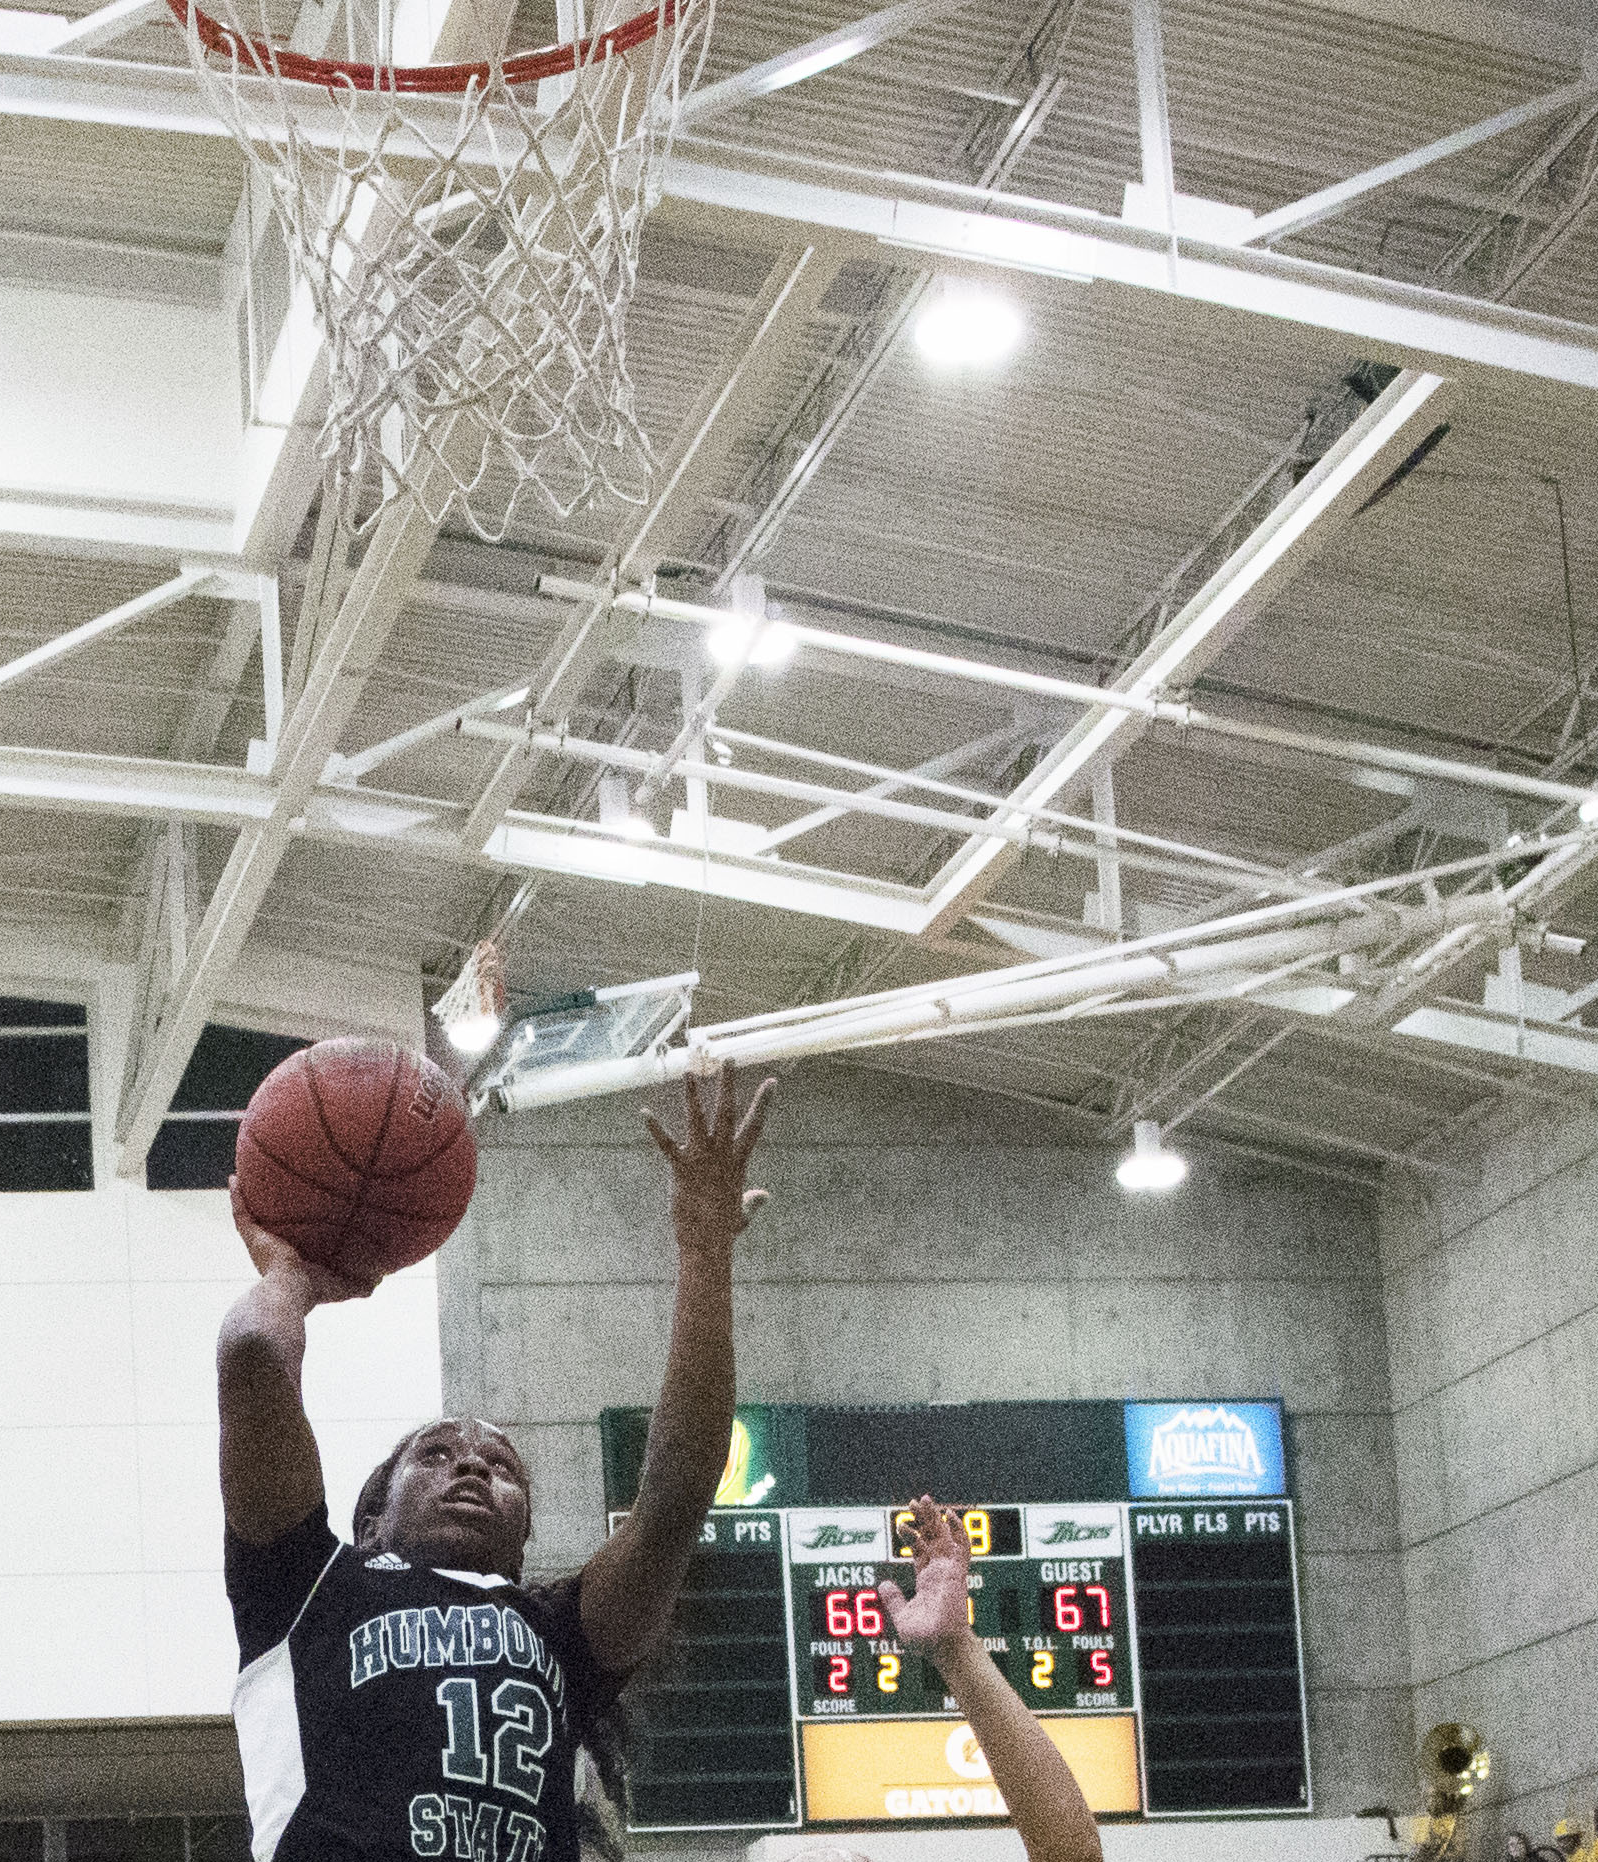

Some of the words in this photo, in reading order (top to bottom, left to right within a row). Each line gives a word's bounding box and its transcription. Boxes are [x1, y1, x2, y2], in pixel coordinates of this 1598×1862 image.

[1148, 1425, 1266, 1478] AQUAFINA
[735, 1521, 771, 1543] PTS
[1136, 1513, 1183, 1535] PLYR
[1193, 1512, 1229, 1533] FLS
[1245, 1511, 1281, 1533] PTS
[814, 1565, 876, 1587] JACKS
[1040, 1561, 1104, 1583] GUEST
[826, 1590, 882, 1637] 66
[1054, 1585, 1110, 1631] 67
[810, 1641, 854, 1655] FOULS
[1072, 1635, 1115, 1650] FOULS
[829, 1655, 850, 1693] 2
[877, 1654, 901, 1692] 2
[1031, 1651, 1055, 1689] 2
[1089, 1649, 1113, 1687] 5
[813, 1699, 856, 1714] SCORE
[1076, 1693, 1118, 1707] SCORE
[436, 1677, 553, 1805] 12
